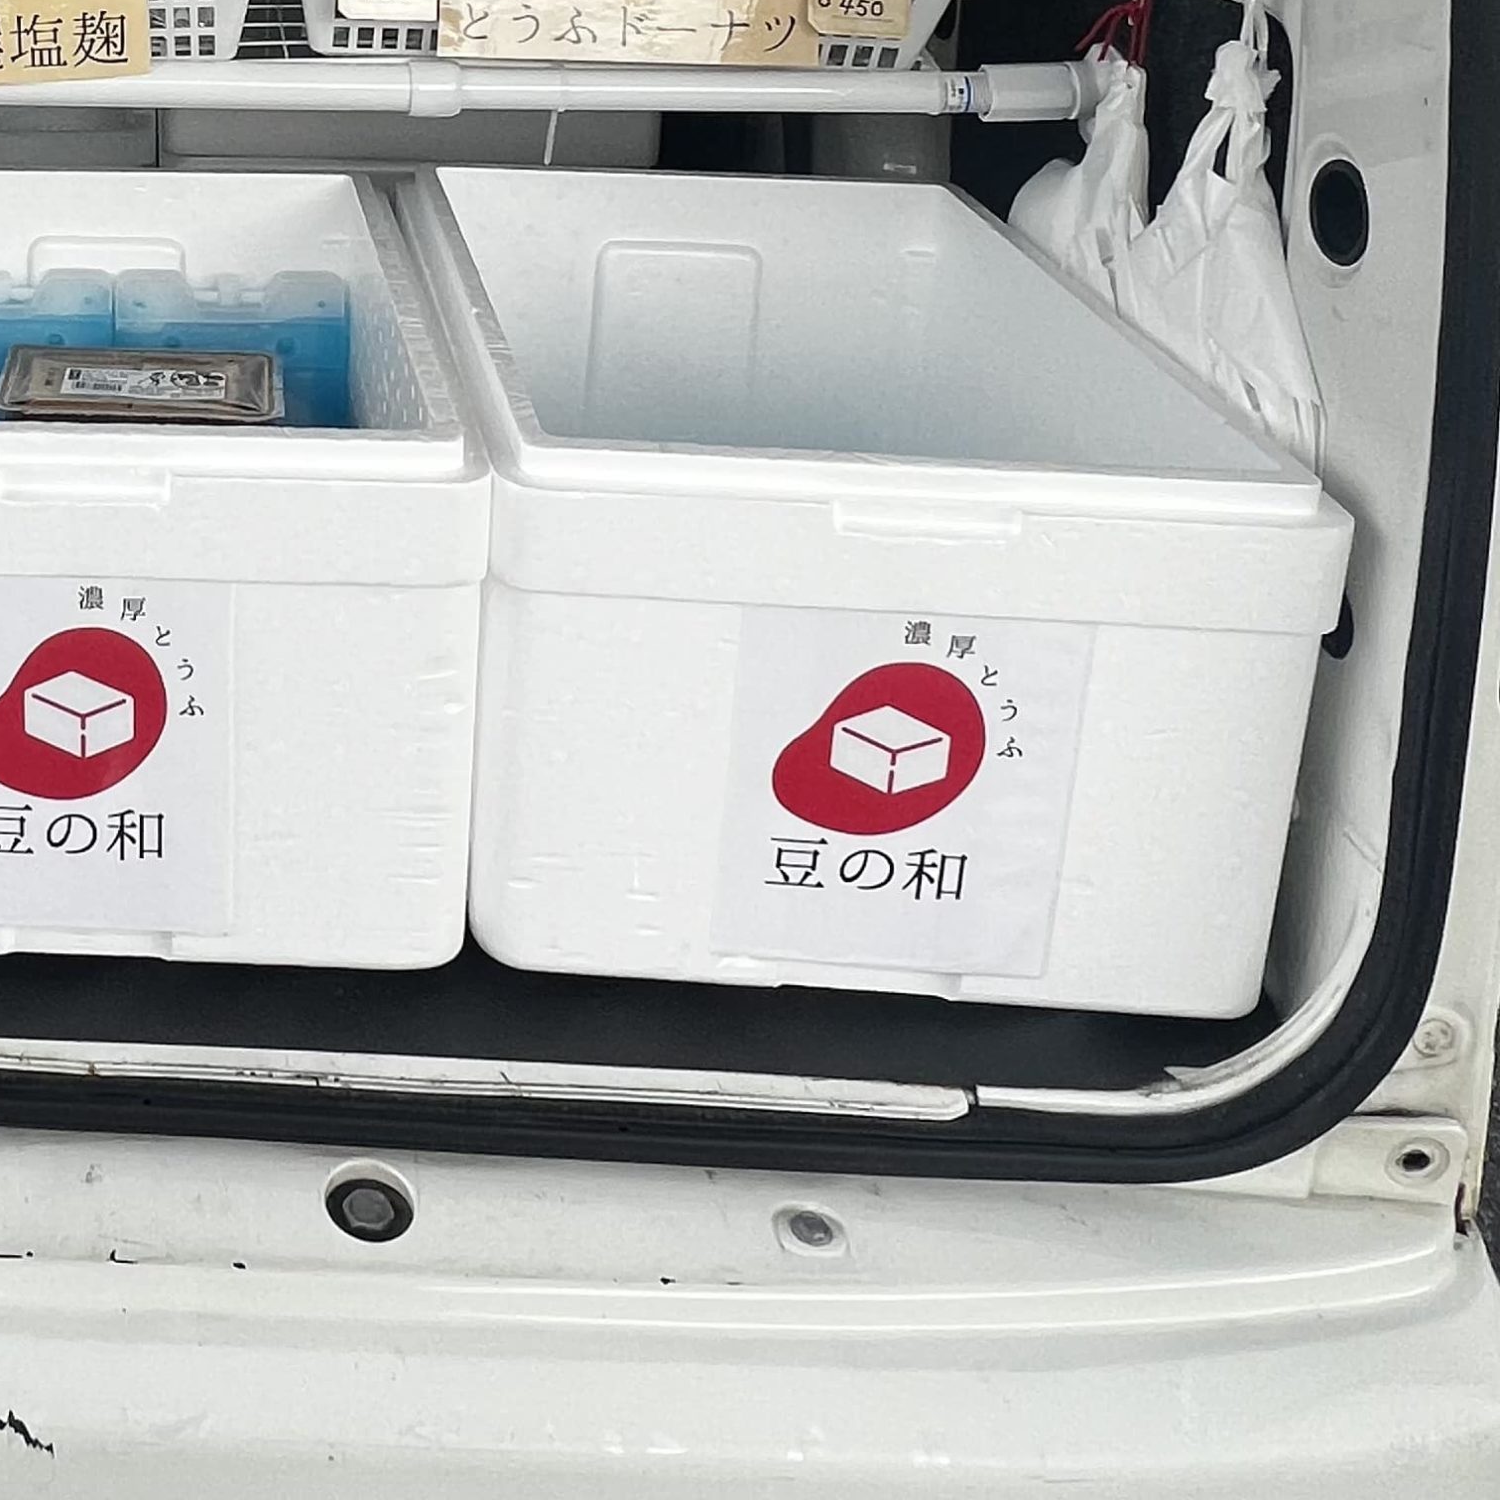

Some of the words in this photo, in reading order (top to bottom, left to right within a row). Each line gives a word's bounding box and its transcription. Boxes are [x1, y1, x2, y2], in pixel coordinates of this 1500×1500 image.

[463, 3, 795, 51] とうふドーナツ
[78, 586, 205, 717] 濃厚とうふ
[904, 620, 1023, 758] 濃厚とうふ
[764, 837, 968, 900] 豆の和
